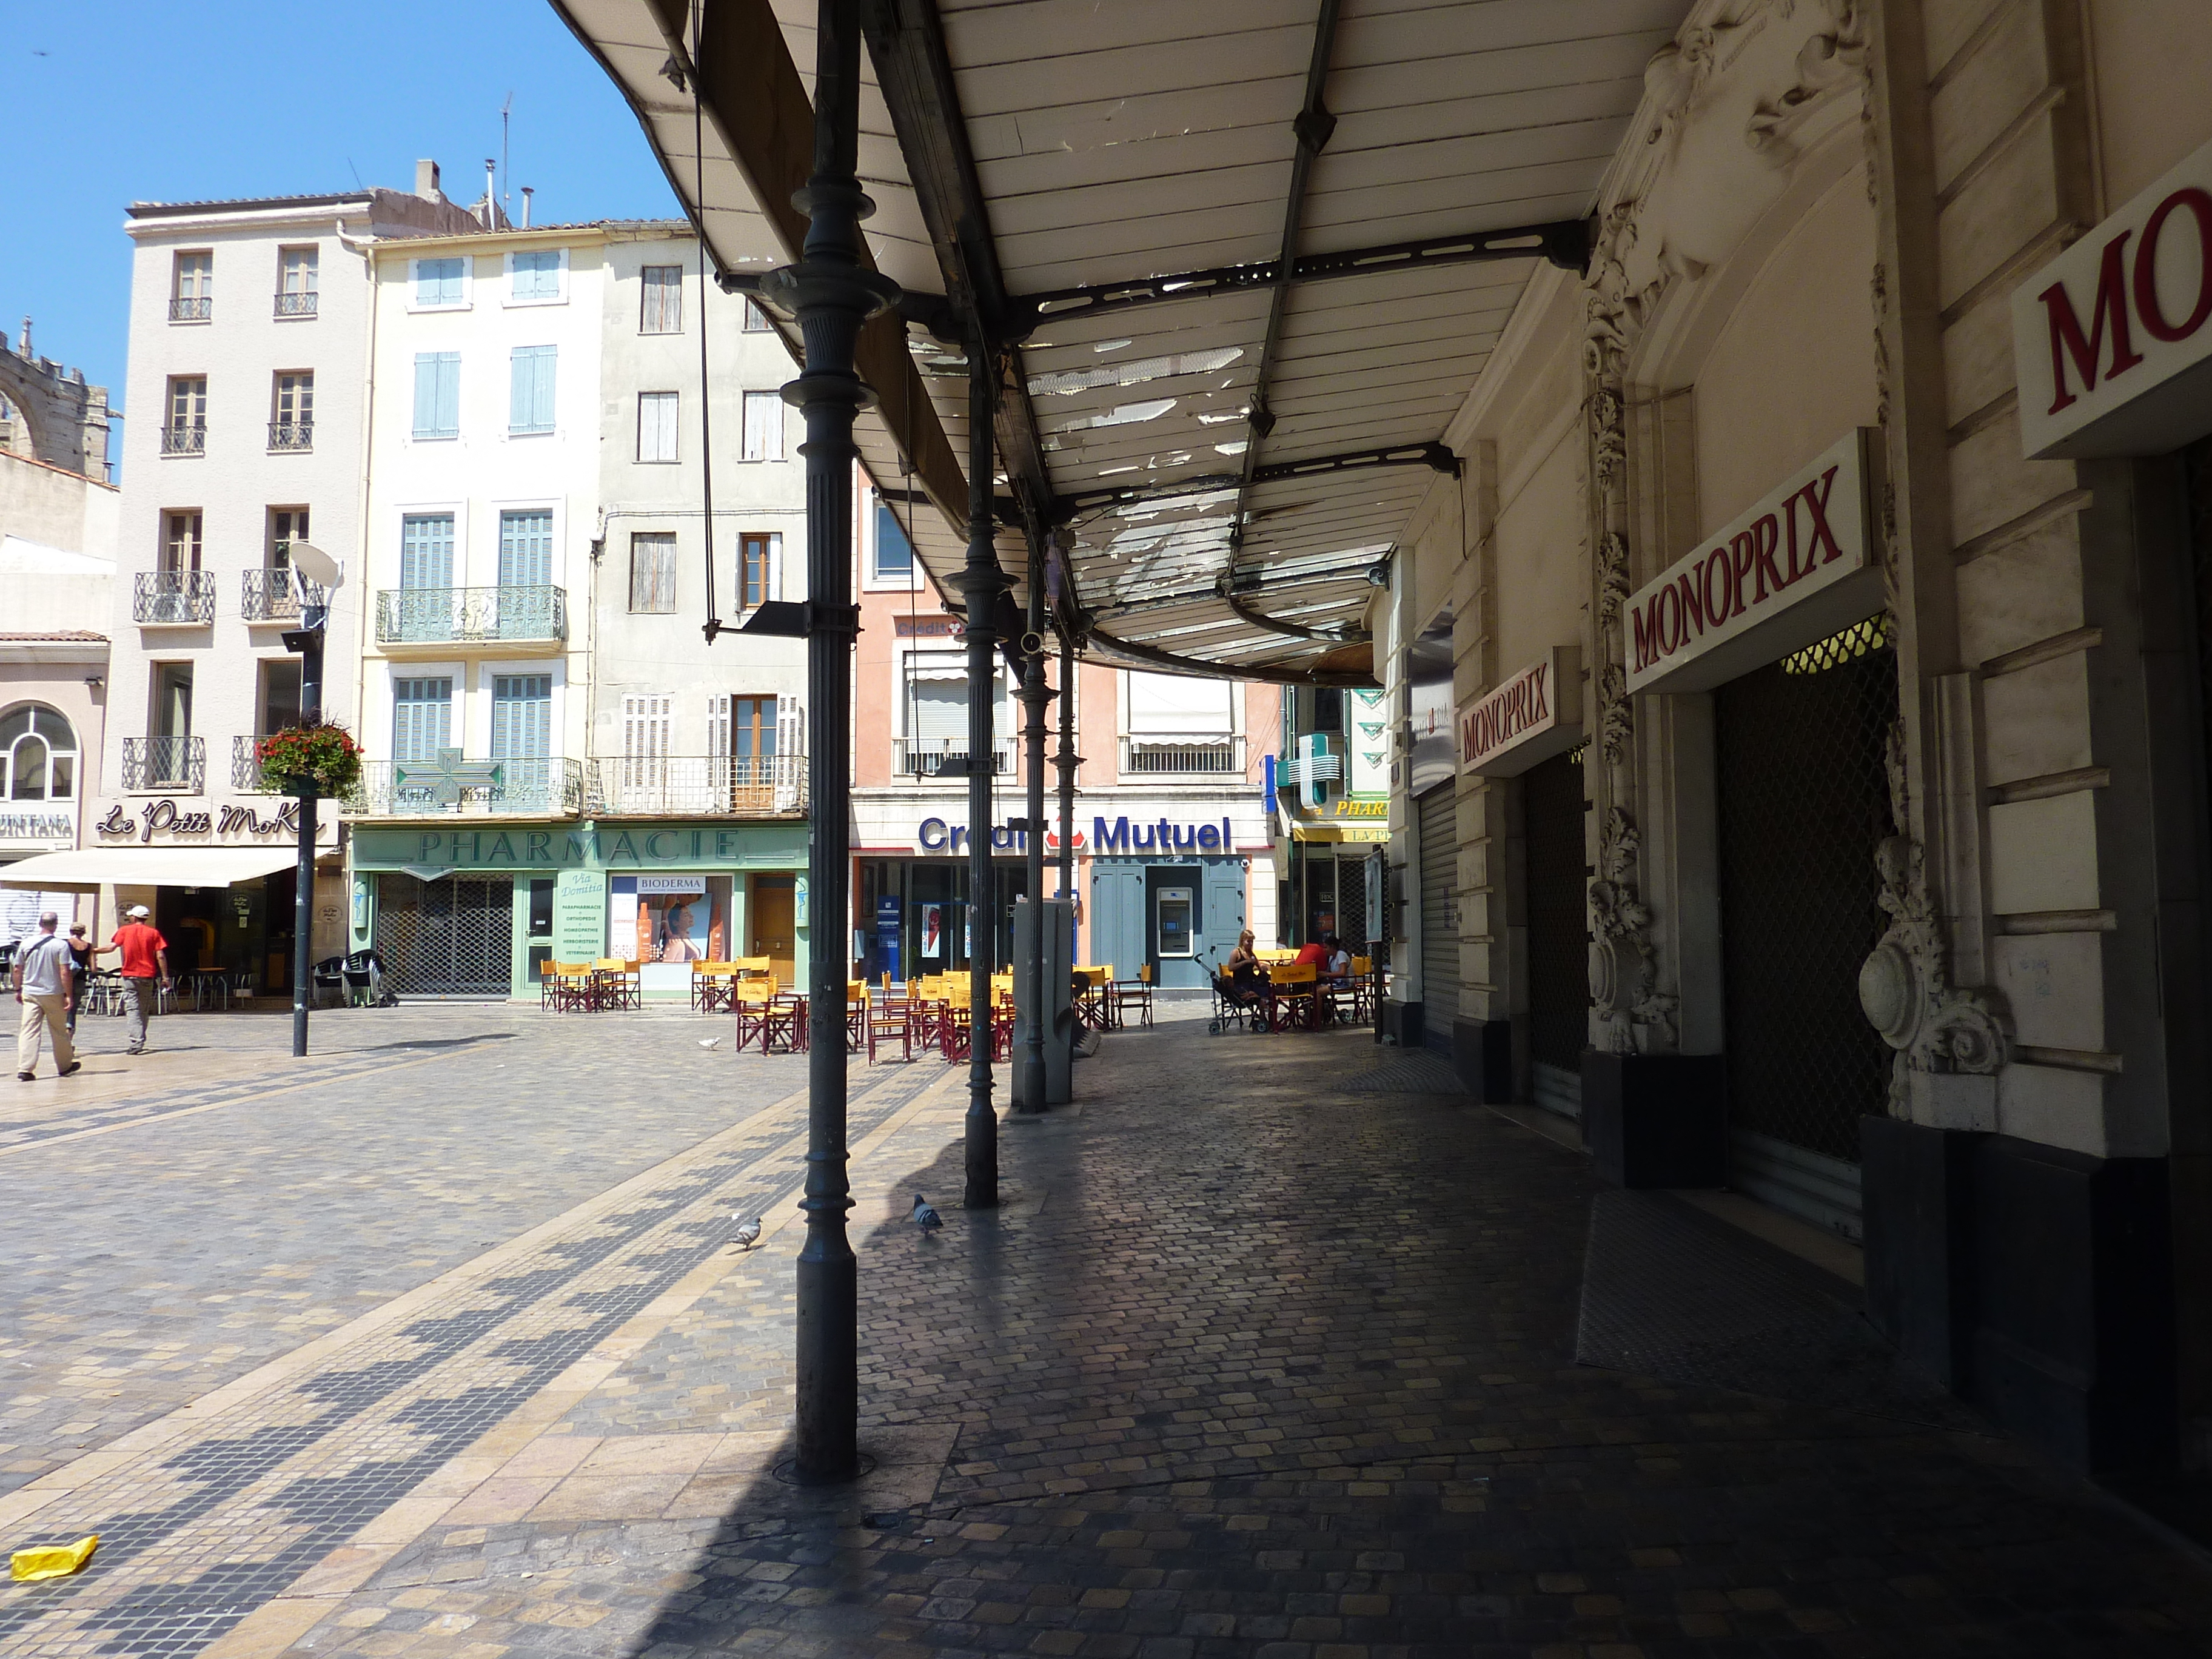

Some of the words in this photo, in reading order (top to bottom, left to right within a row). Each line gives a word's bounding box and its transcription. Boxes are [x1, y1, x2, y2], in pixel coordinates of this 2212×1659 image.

[2038, 187, 2212, 416] MO
[1631, 466, 1842, 674] MONOPRIX
[898, 622, 946, 635] Crédit
[1463, 663, 1549, 764] MONOPRIX
[1335, 800, 1391, 816] PHAR
[96, 805, 136, 834] Le
[141, 800, 212, 842] Petit
[217, 802, 326, 834] MoK
[1093, 816, 1230, 848] Mutuel
[418, 830, 738, 863] PHARMACIE
[1353, 830, 1370, 841] LA
[561, 882, 603, 897] Domitia
[572, 873, 591, 885] Via
[642, 879, 701, 888] BIODERMA
